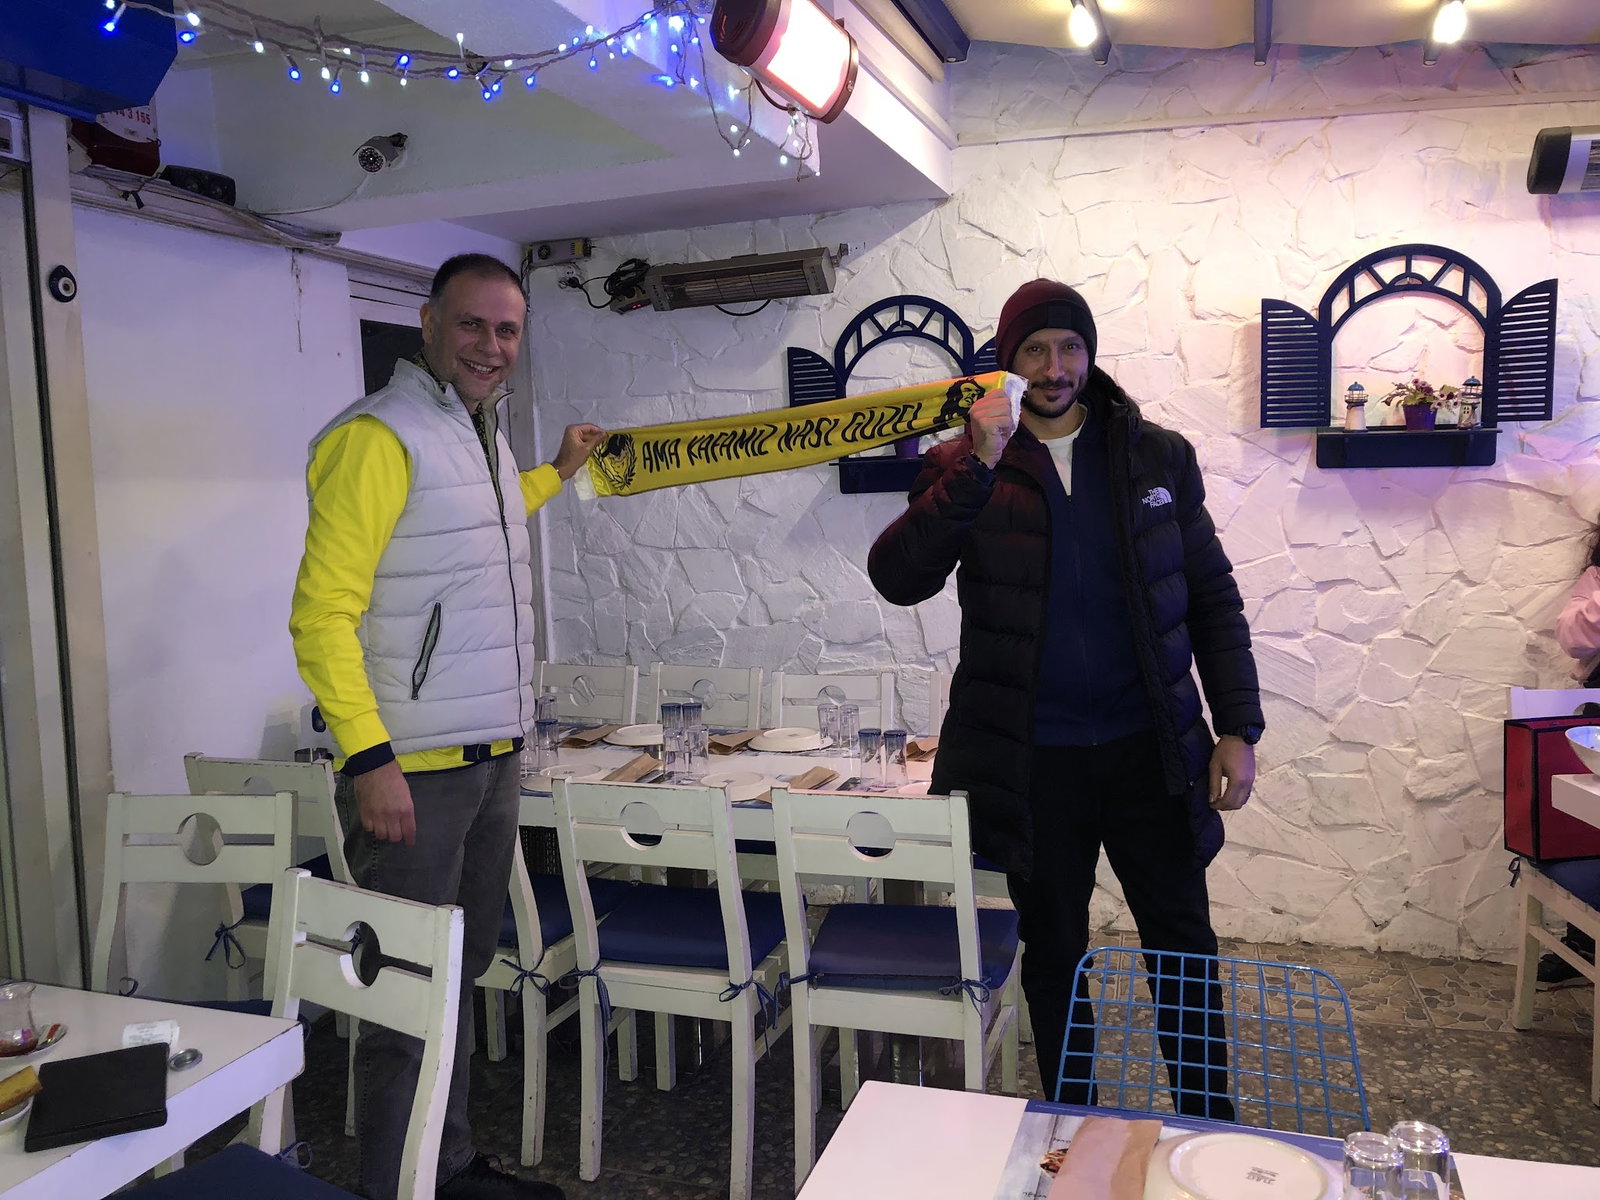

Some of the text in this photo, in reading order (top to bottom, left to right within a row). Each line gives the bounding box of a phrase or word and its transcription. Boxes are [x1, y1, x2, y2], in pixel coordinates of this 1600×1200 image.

[128, 109, 133, 119] 3
[136, 110, 151, 125] 155
[642, 402, 922, 474] AMA KAFAMIZ NASI GÜZEL
[1148, 488, 1159, 497] THE
[1142, 493, 1160, 504] NORTH
[1150, 499, 1165, 508] FACE
